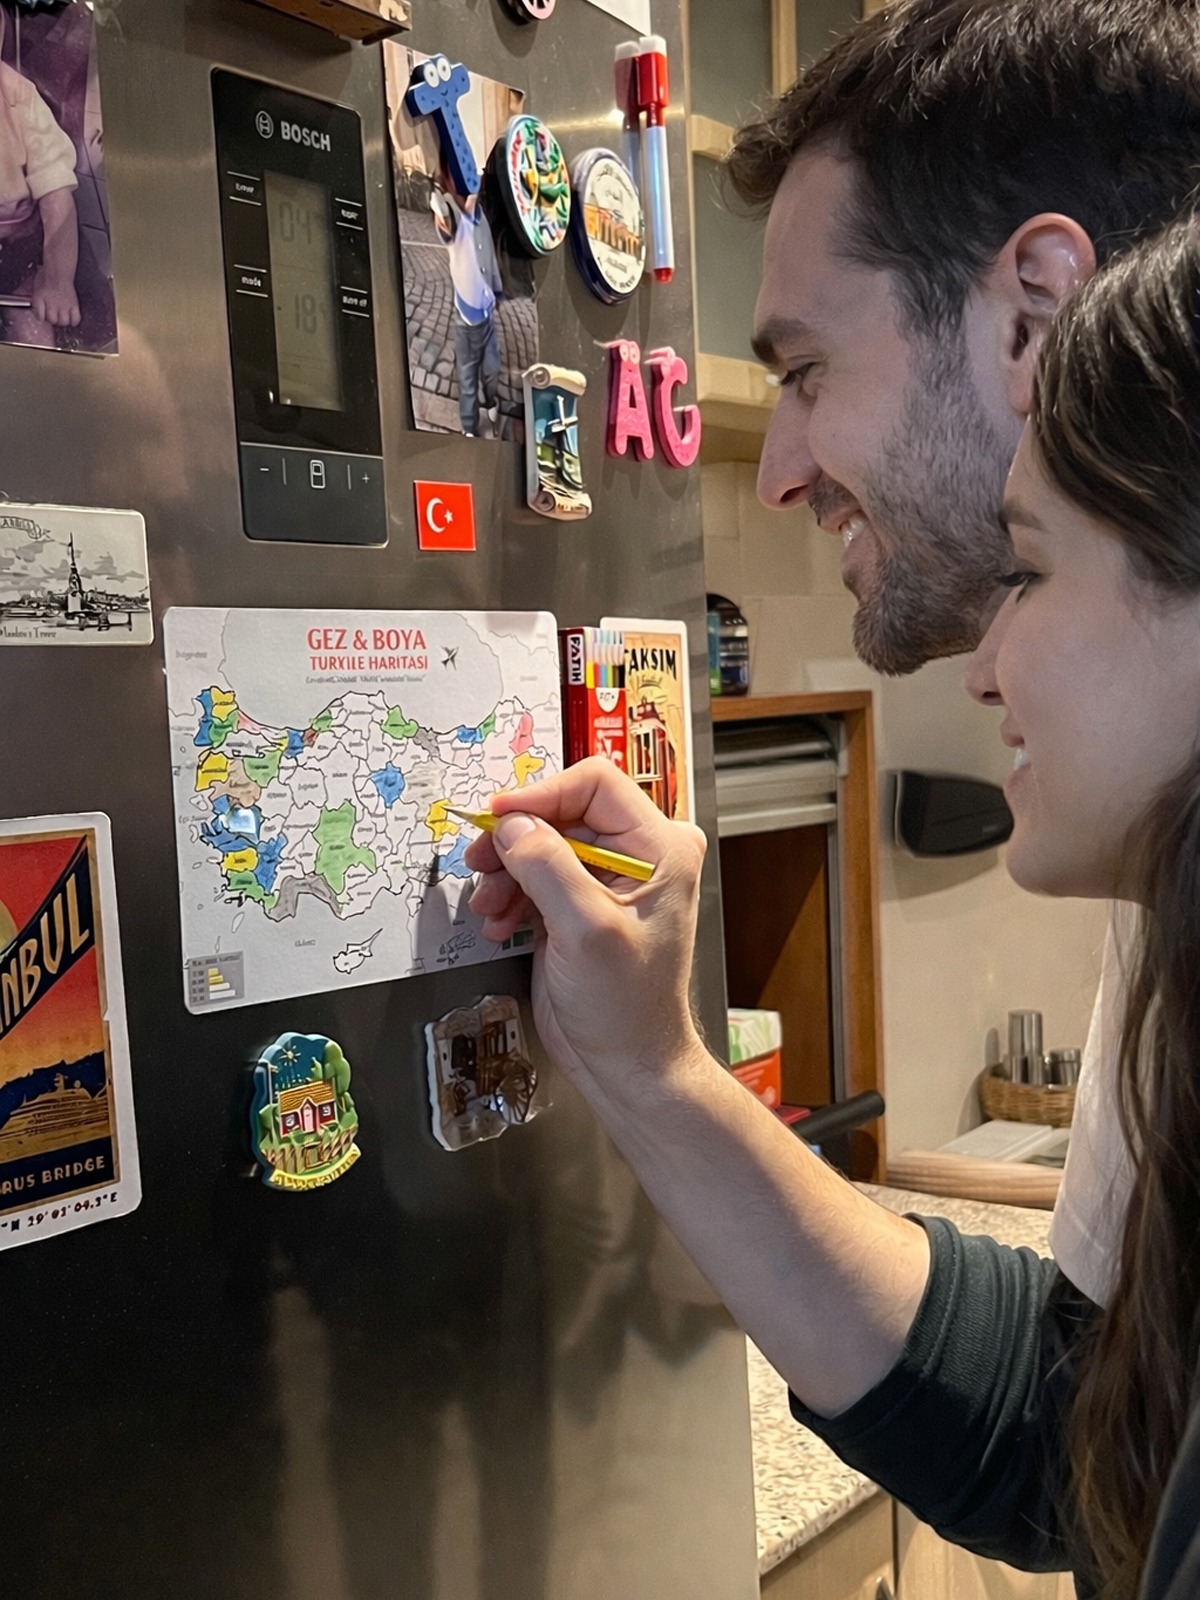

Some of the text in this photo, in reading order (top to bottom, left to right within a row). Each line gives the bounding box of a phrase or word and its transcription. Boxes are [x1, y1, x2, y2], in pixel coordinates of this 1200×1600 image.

[280, 120, 331, 152] BOSCH
[307, 628, 427, 650] GEZ & BOYA
[624, 648, 677, 681] AKSIM
[0, 872, 90, 1034] NBUL
[41, 1155, 106, 1184] BRIDGE
